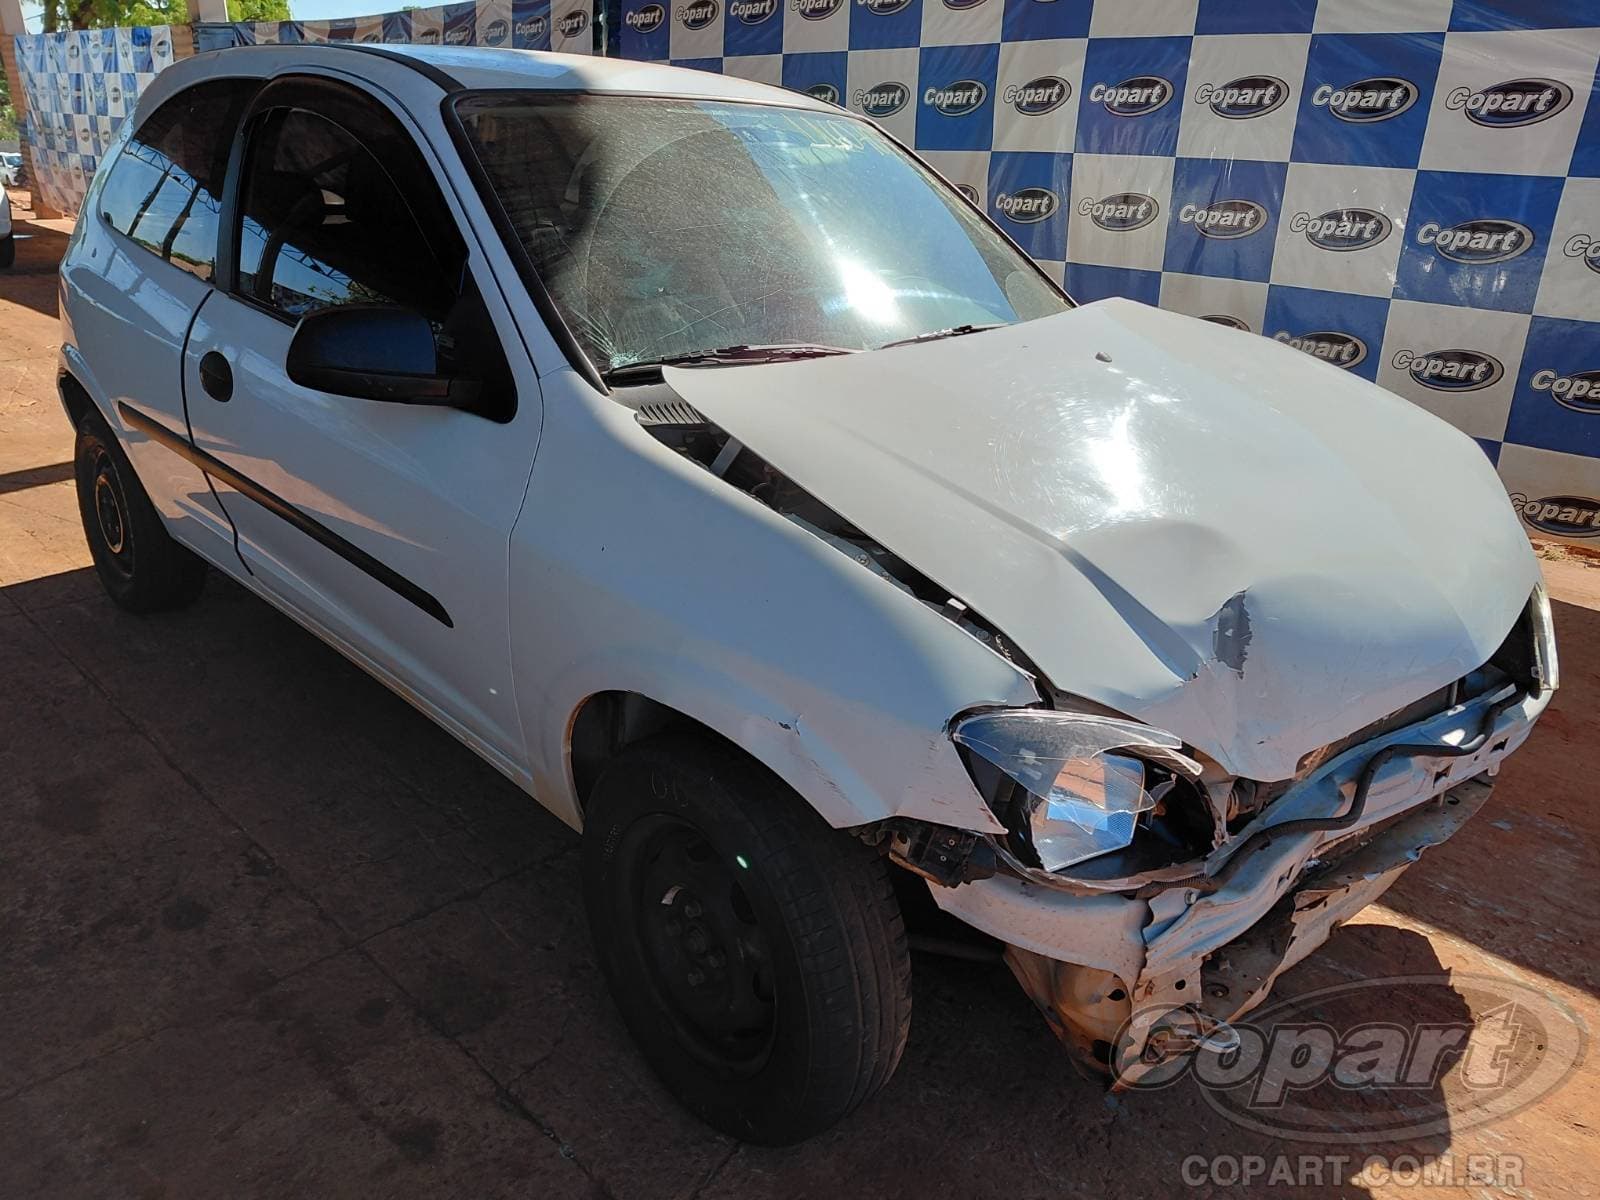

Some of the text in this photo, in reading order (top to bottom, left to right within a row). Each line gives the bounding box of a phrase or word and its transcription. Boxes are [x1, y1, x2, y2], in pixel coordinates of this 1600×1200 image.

[625, 10, 661, 26] Copart
[675, 4, 713, 24] Copart
[729, 0, 771, 19] Copart
[515, 20, 542, 36] Copart
[853, 86, 902, 109] Copart
[924, 84, 980, 109] Copart
[1003, 82, 1062, 110] Copart
[1089, 81, 1166, 107] Copart
[1195, 82, 1281, 113] Copart
[1311, 83, 1406, 112] Copart
[1445, 86, 1555, 118] Copart
[996, 192, 1051, 214] Copart
[1078, 196, 1150, 220] Copart
[1179, 202, 1256, 228] Copart
[1290, 211, 1378, 240] Copart
[1416, 222, 1520, 251] Copart
[1391, 349, 1490, 382] Copart
[1530, 369, 1600, 401] Copa
